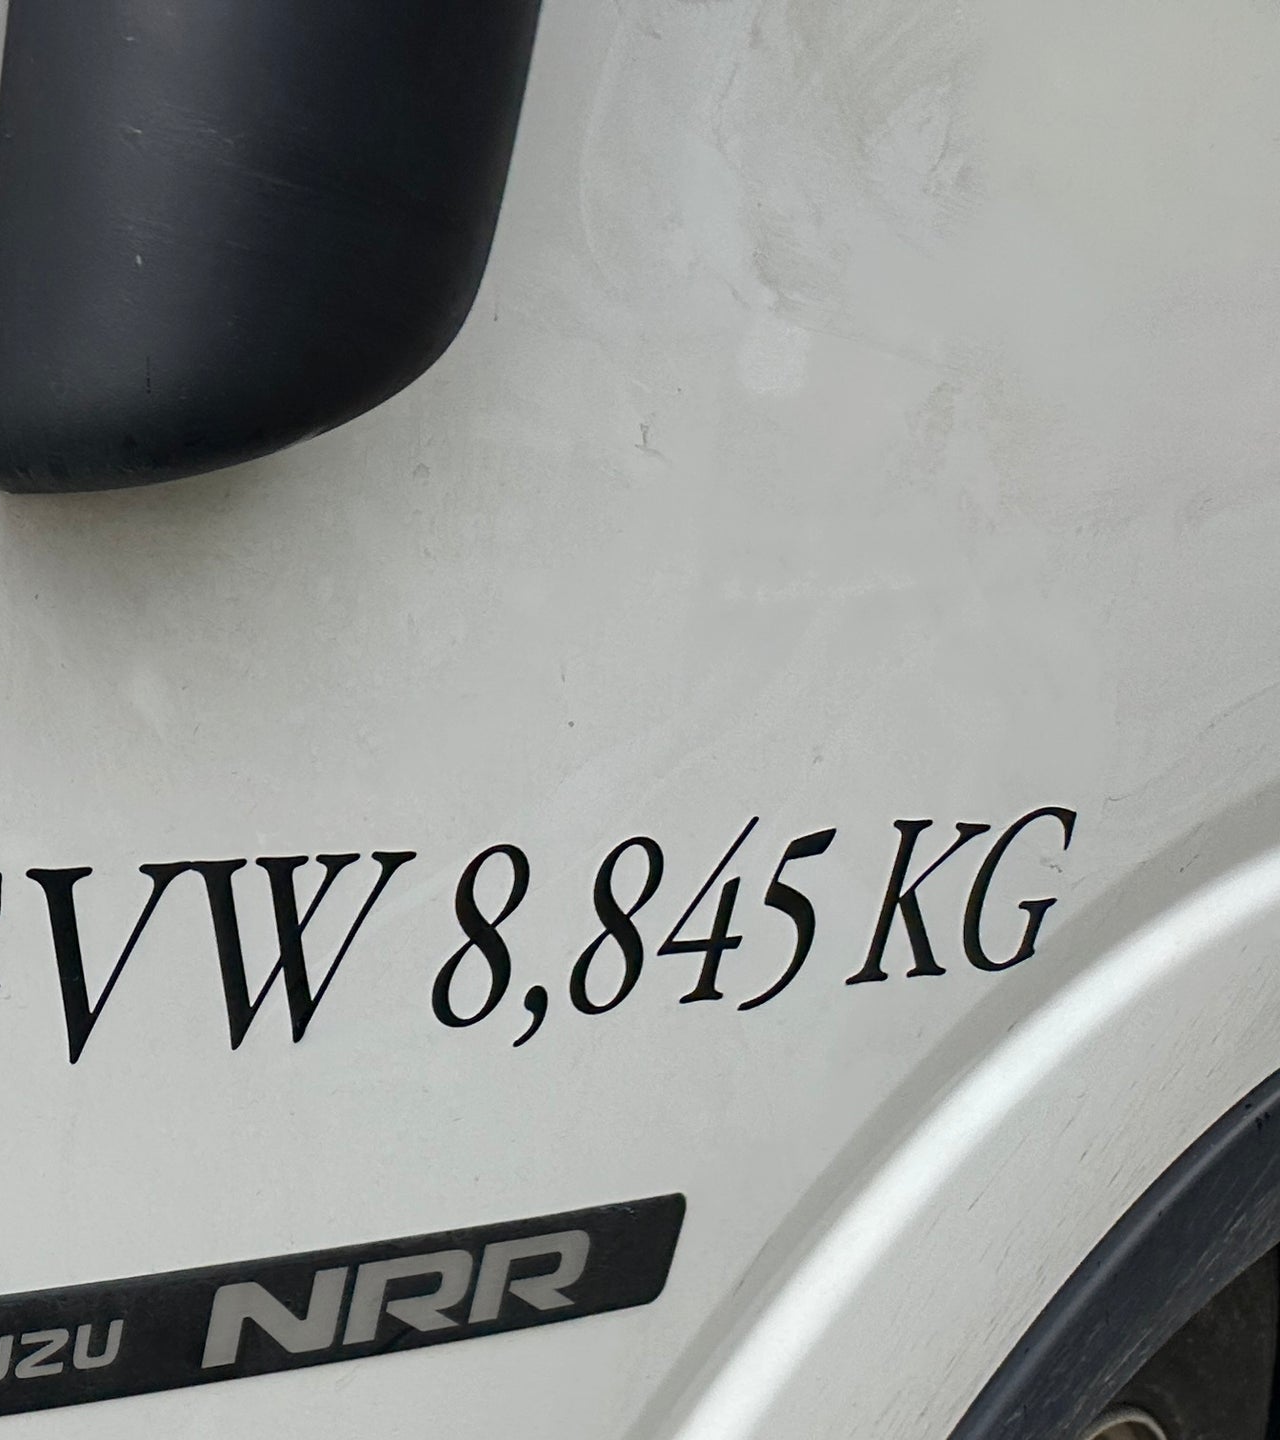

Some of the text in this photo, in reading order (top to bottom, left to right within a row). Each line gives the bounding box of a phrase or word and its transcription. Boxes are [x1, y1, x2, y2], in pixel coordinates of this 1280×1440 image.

[430, 815, 838, 1048] 8,845
[844, 806, 1079, 986] KG
[200, 1229, 591, 1369] NRR
